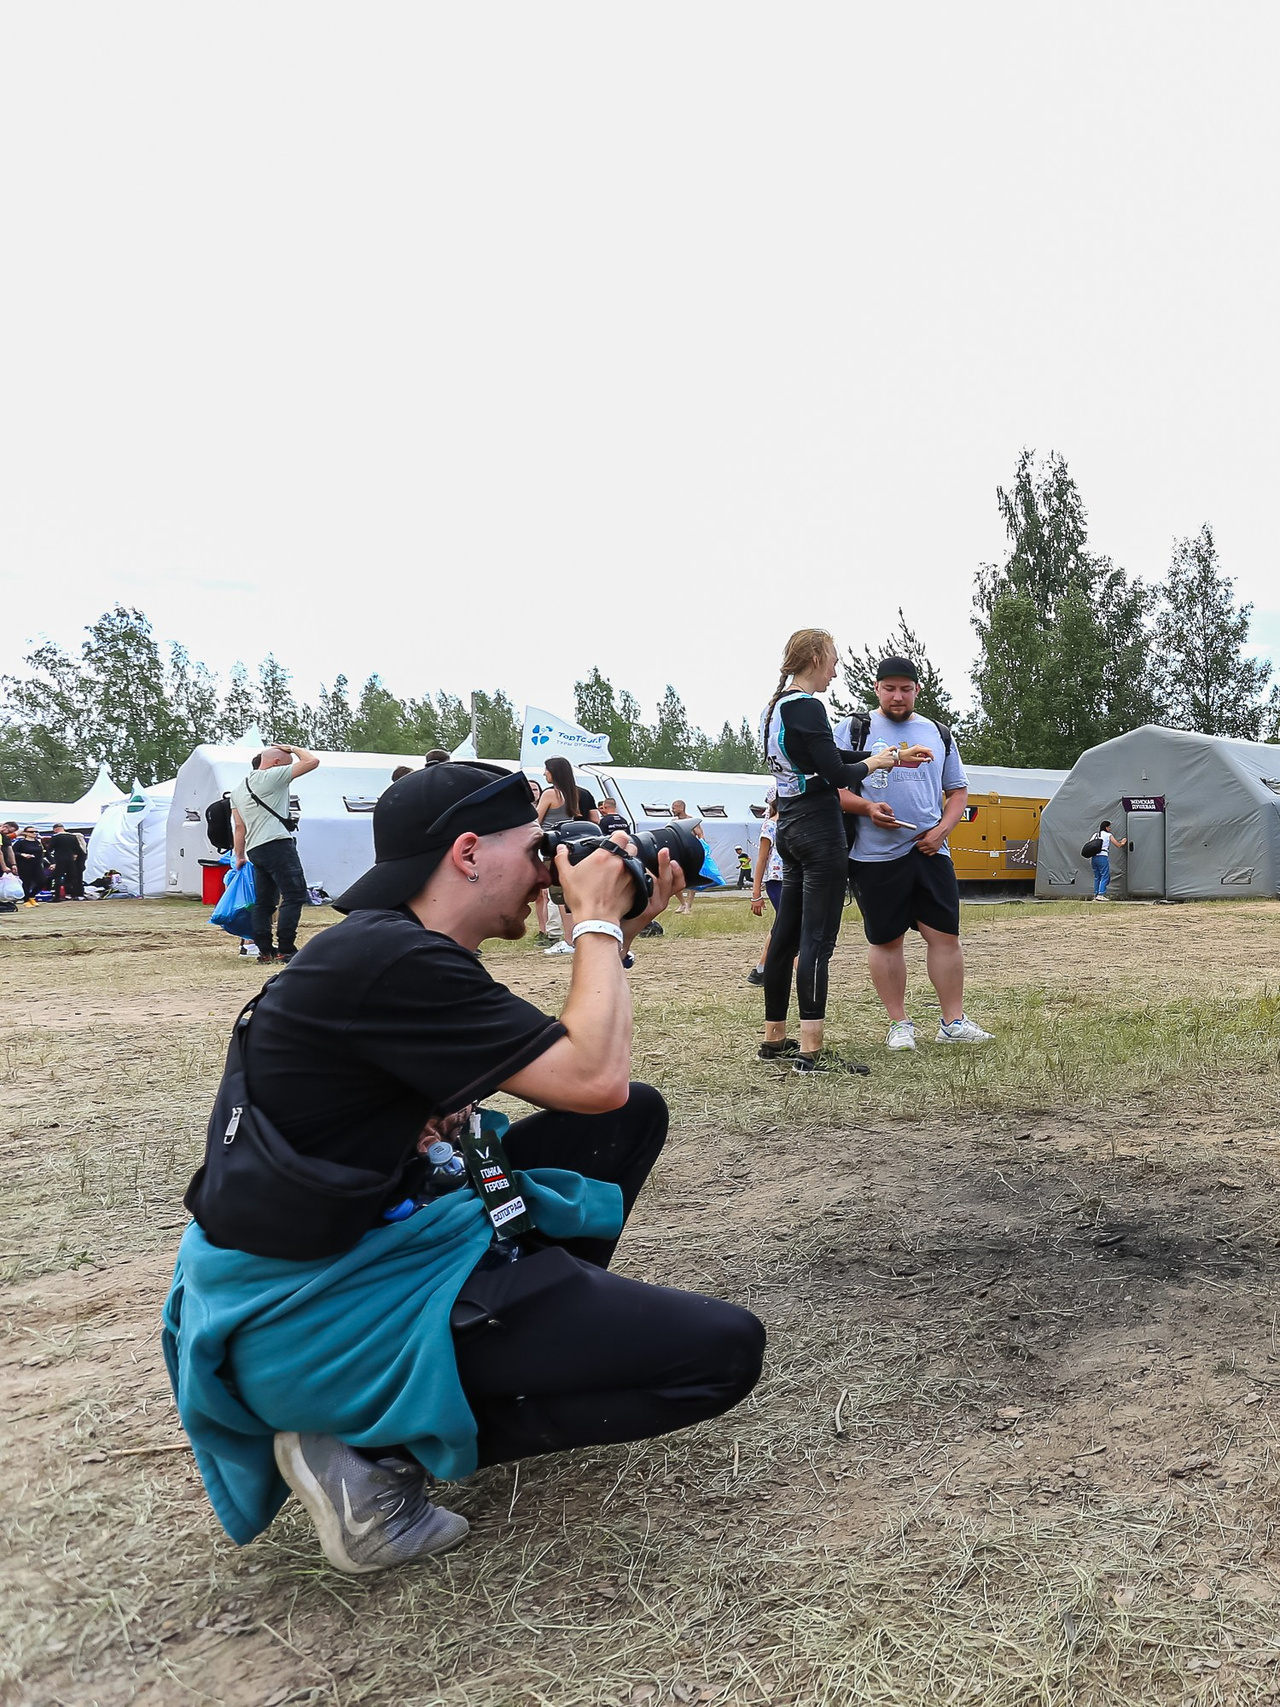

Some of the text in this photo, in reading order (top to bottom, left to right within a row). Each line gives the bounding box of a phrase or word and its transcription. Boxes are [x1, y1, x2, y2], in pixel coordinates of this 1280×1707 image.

[480, 1165, 504, 1179] ГОНКА
[484, 1178, 510, 1193] ГЕРОЕВ
[493, 1199, 524, 1222] ФОТОГРАФ
